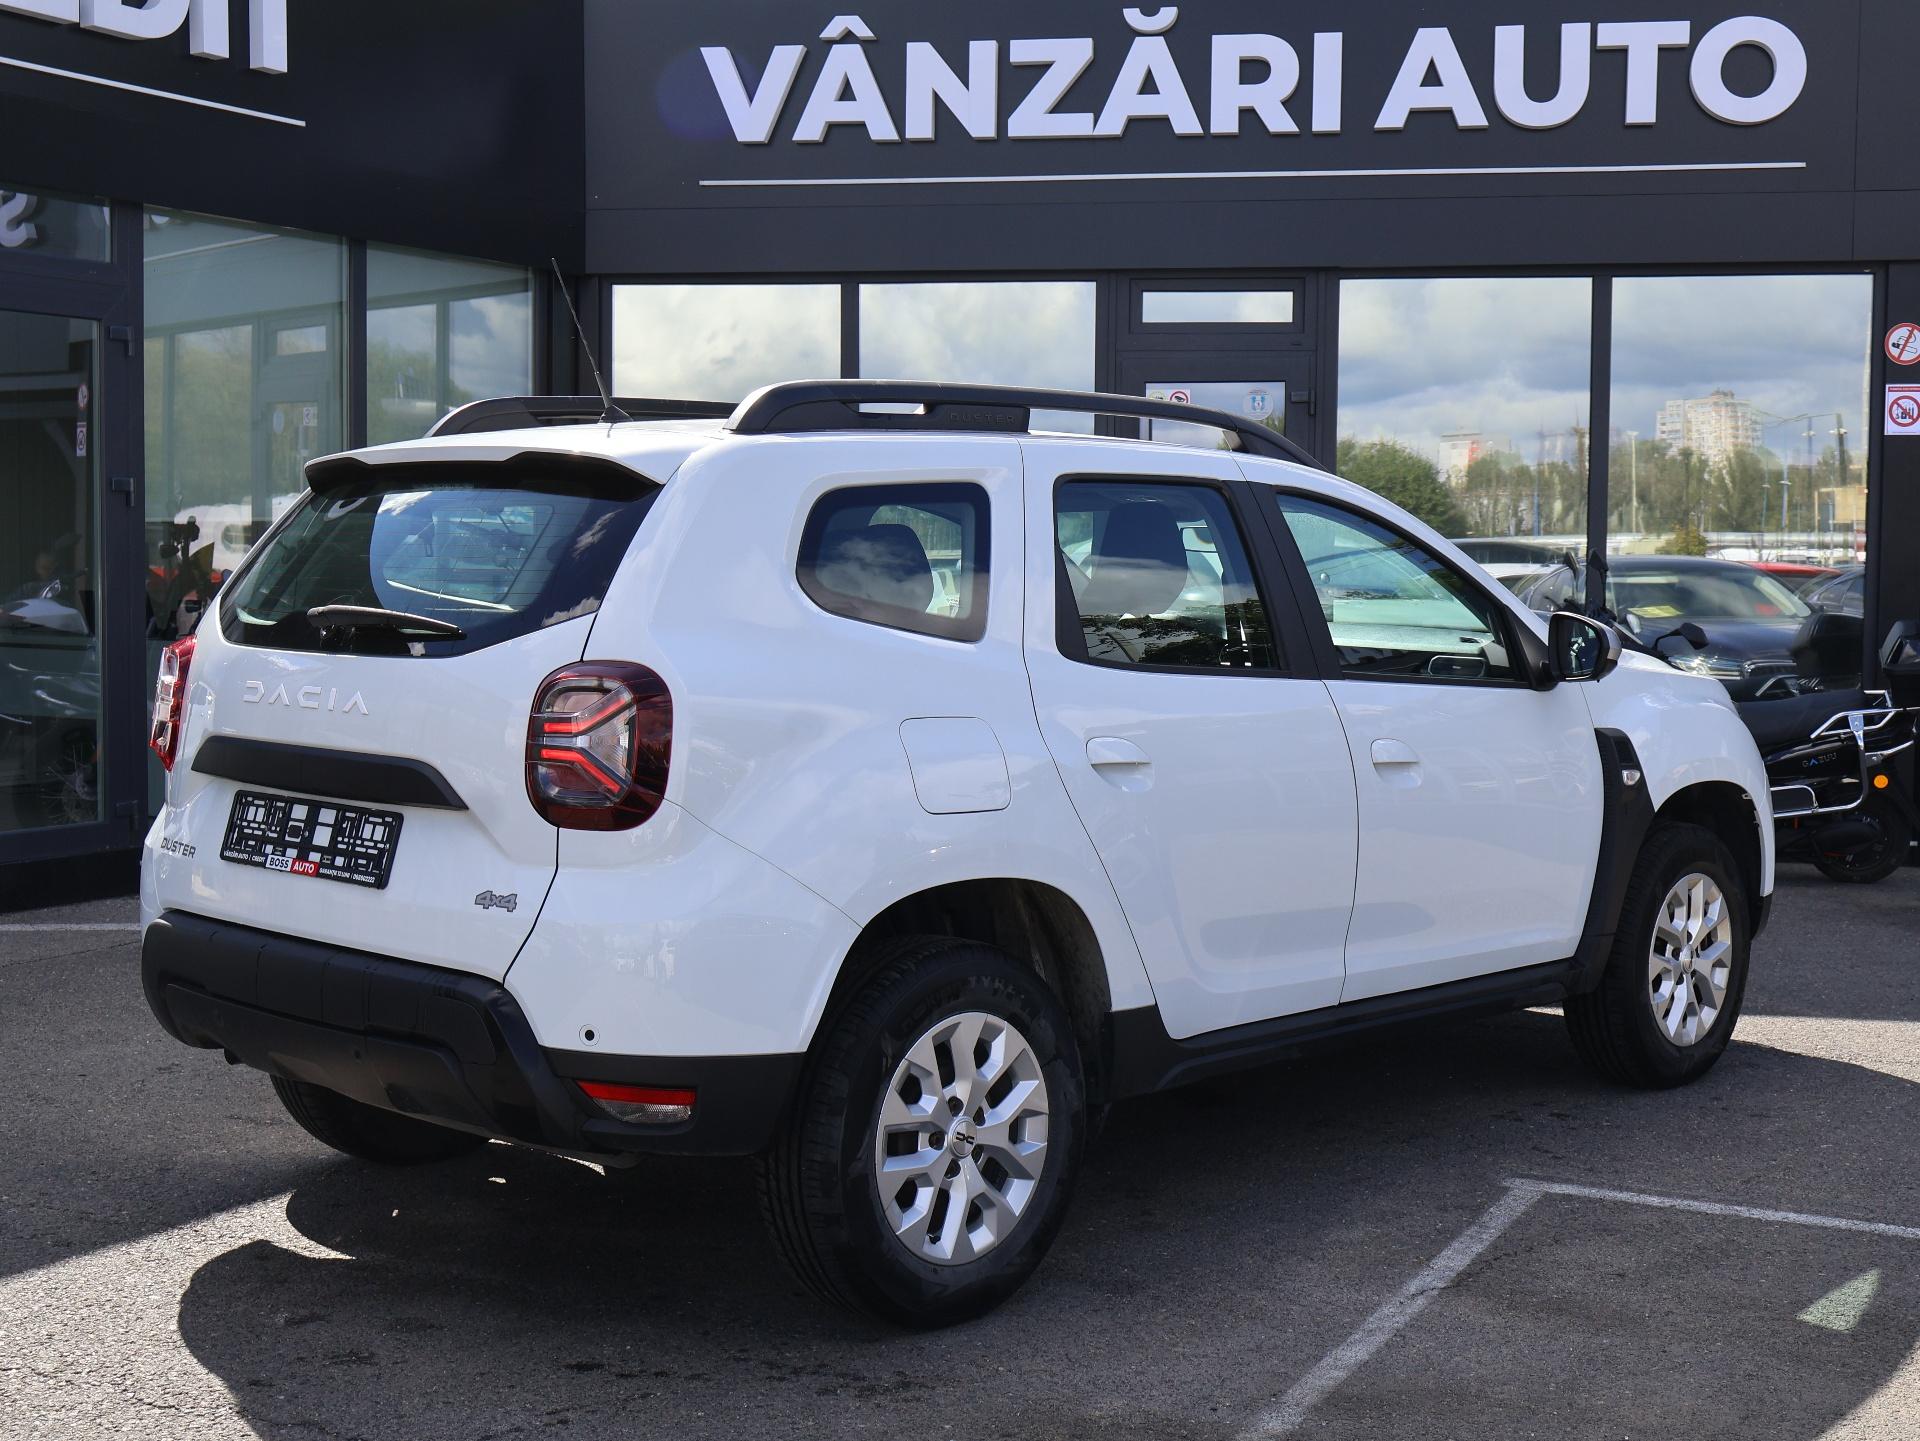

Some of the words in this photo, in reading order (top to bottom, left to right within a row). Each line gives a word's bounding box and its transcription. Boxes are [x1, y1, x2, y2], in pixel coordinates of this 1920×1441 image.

[700, 6, 1343, 144] VÂNZĂRI
[1374, 15, 1808, 131] AUTO
[242, 679, 369, 716] DACIA
[160, 836, 197, 859] DUSTER
[269, 856, 290, 869] BOSS
[293, 863, 315, 874] AUTO
[474, 889, 518, 913] 4x4
